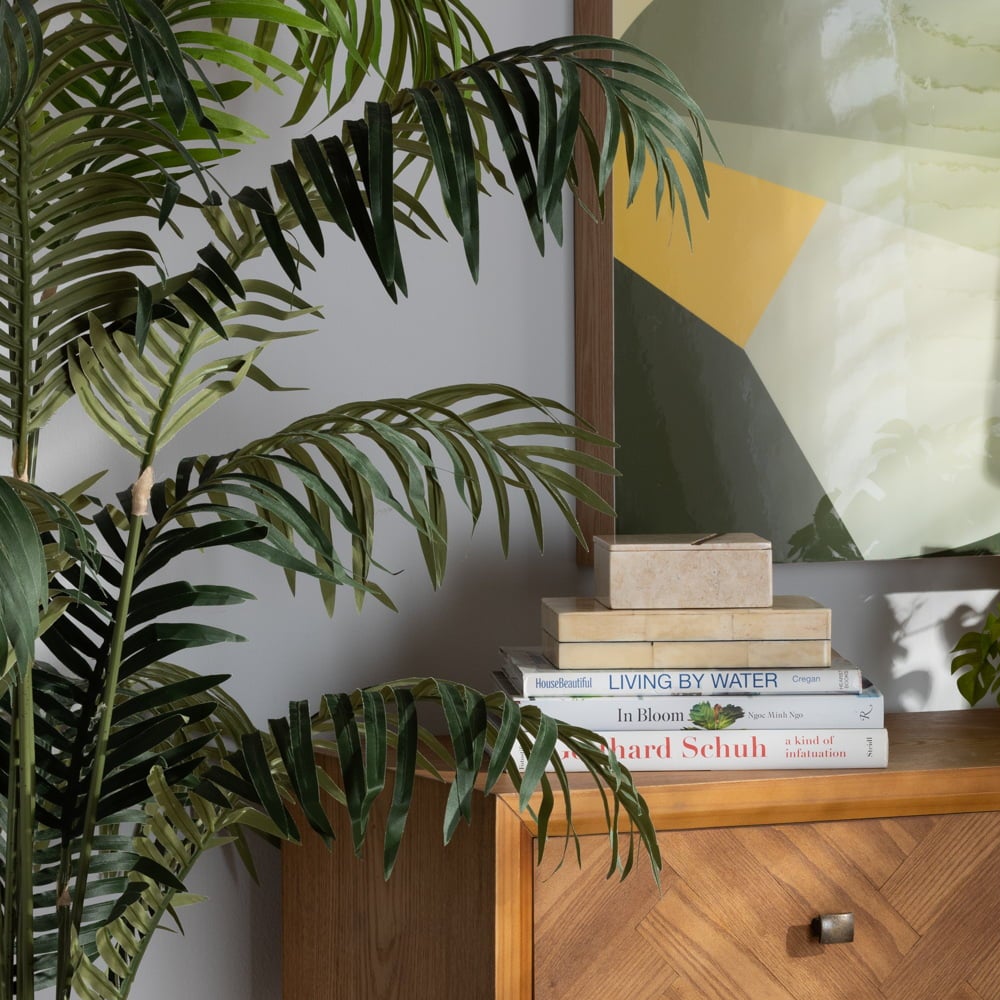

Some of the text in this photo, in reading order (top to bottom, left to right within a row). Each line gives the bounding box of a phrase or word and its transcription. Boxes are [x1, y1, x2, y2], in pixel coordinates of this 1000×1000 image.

[535, 677, 592, 688] HouseBeautiful
[609, 672, 778, 690] LIVING BY WATER
[792, 675, 821, 684] Cregan
[618, 707, 684, 722] In Bloom
[748, 711, 804, 720] Ngoc Minh Ngo
[785, 735, 835, 745] a kind of
[682, 735, 768, 759] Schuh
[785, 748, 847, 758] infatuation
